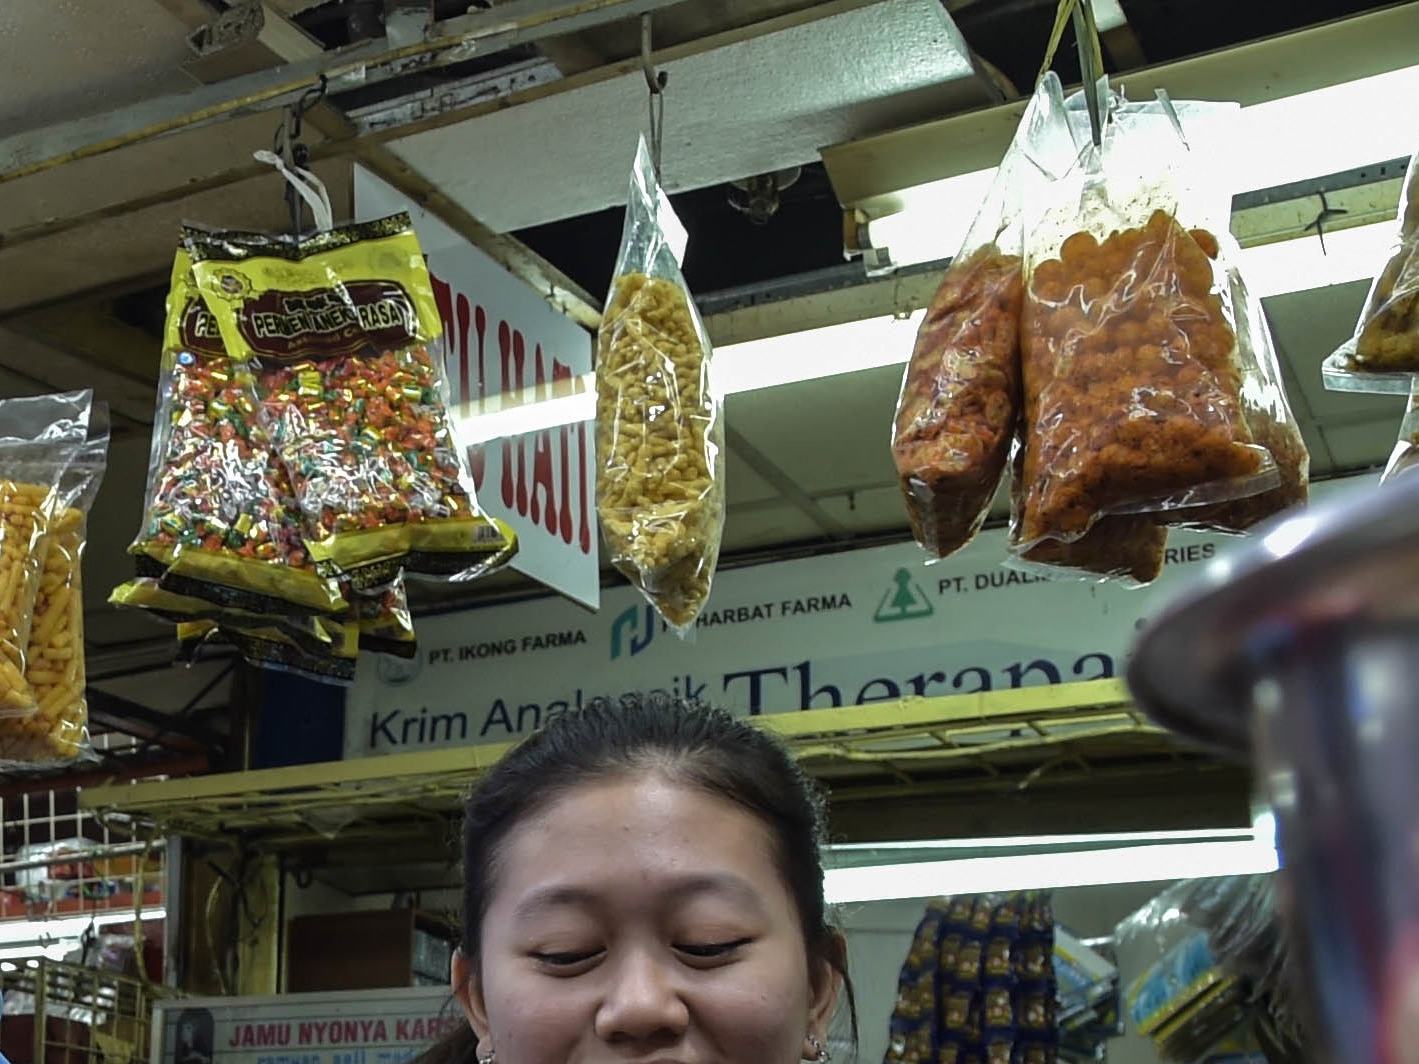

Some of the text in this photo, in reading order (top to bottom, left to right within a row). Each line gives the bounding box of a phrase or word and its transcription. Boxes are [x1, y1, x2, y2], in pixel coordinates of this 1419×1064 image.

[358, 300, 402, 332] RASA
[1163, 543, 1216, 566] RIES
[938, 577, 968, 595] PT.
[781, 592, 854, 617] FARMA
[428, 629, 587, 665] PT. IKONG FARMA
[370, 707, 468, 748] Krim
[723, 649, 1117, 717] Therapa
[229, 1022, 292, 1048] JAMU
[297, 1018, 388, 1046] NYONYA
